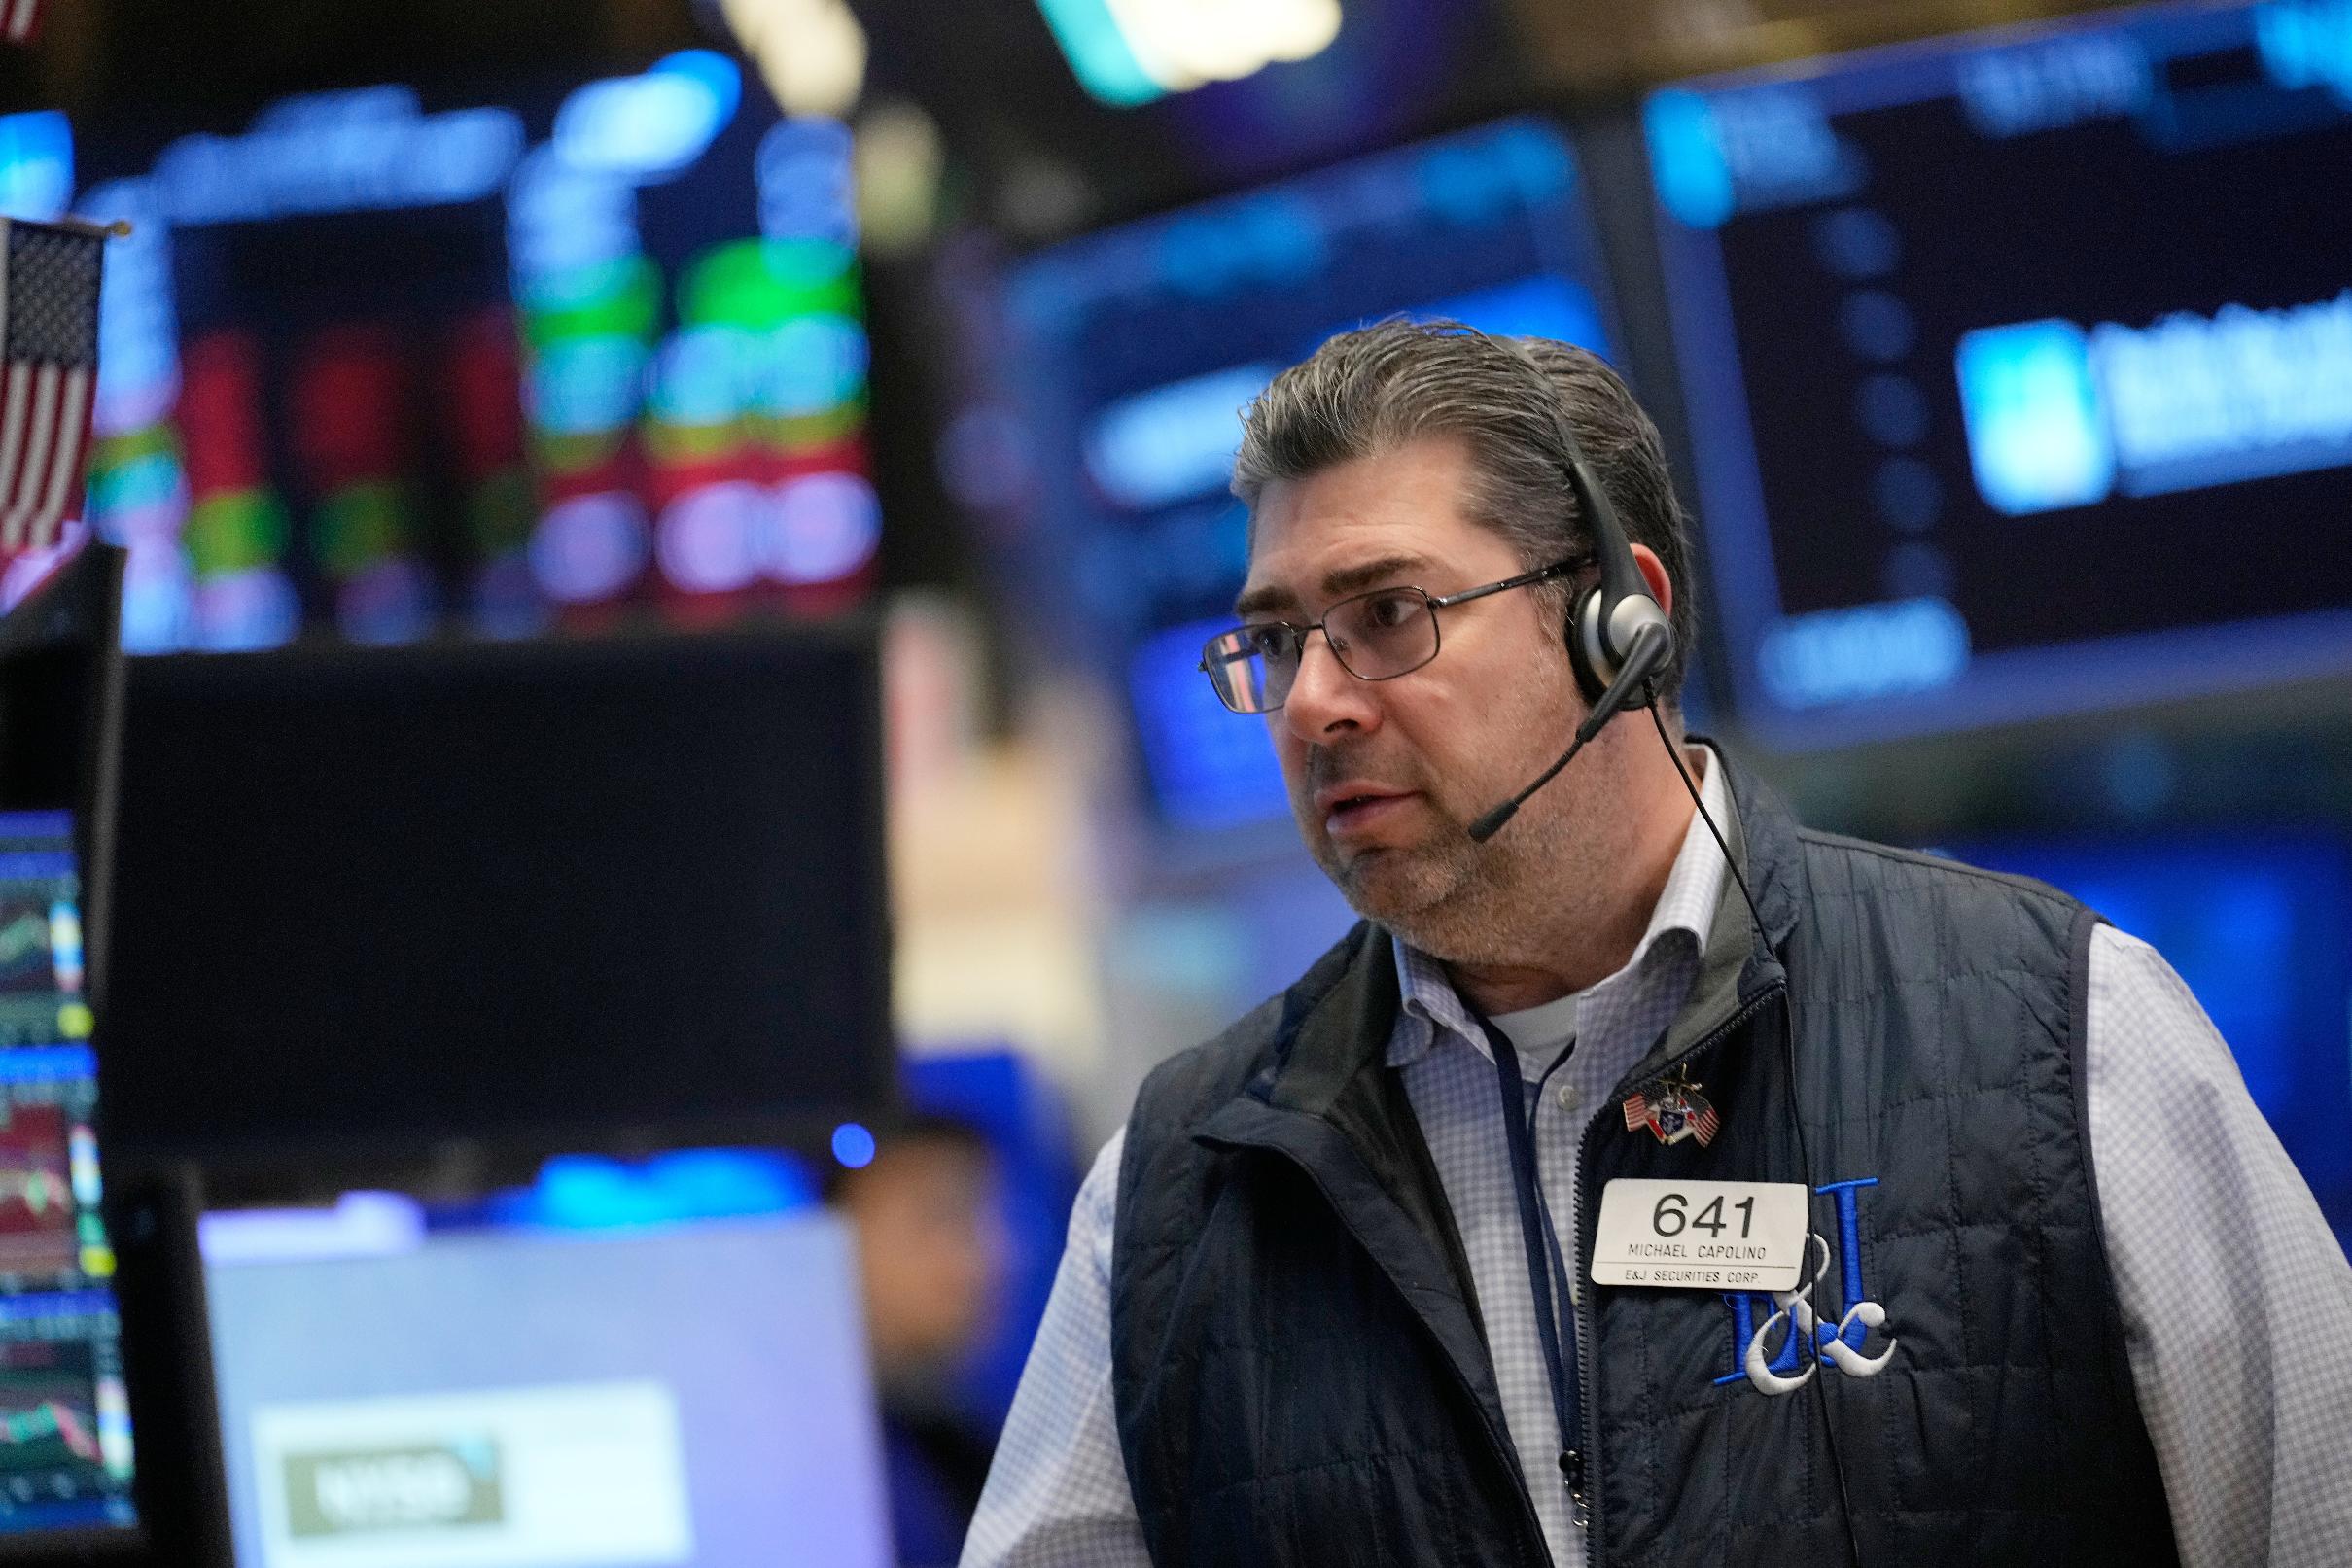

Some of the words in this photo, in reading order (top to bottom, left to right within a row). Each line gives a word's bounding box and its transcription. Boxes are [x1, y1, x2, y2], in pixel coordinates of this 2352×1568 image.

[1653, 1194, 1755, 1238] 641
[1628, 1244, 1688, 1258] MICHAEL
[1698, 1245, 1766, 1260] CAPOLINO
[1625, 1269, 1647, 1281] E&J
[1654, 1270, 1720, 1283] SECURITIES
